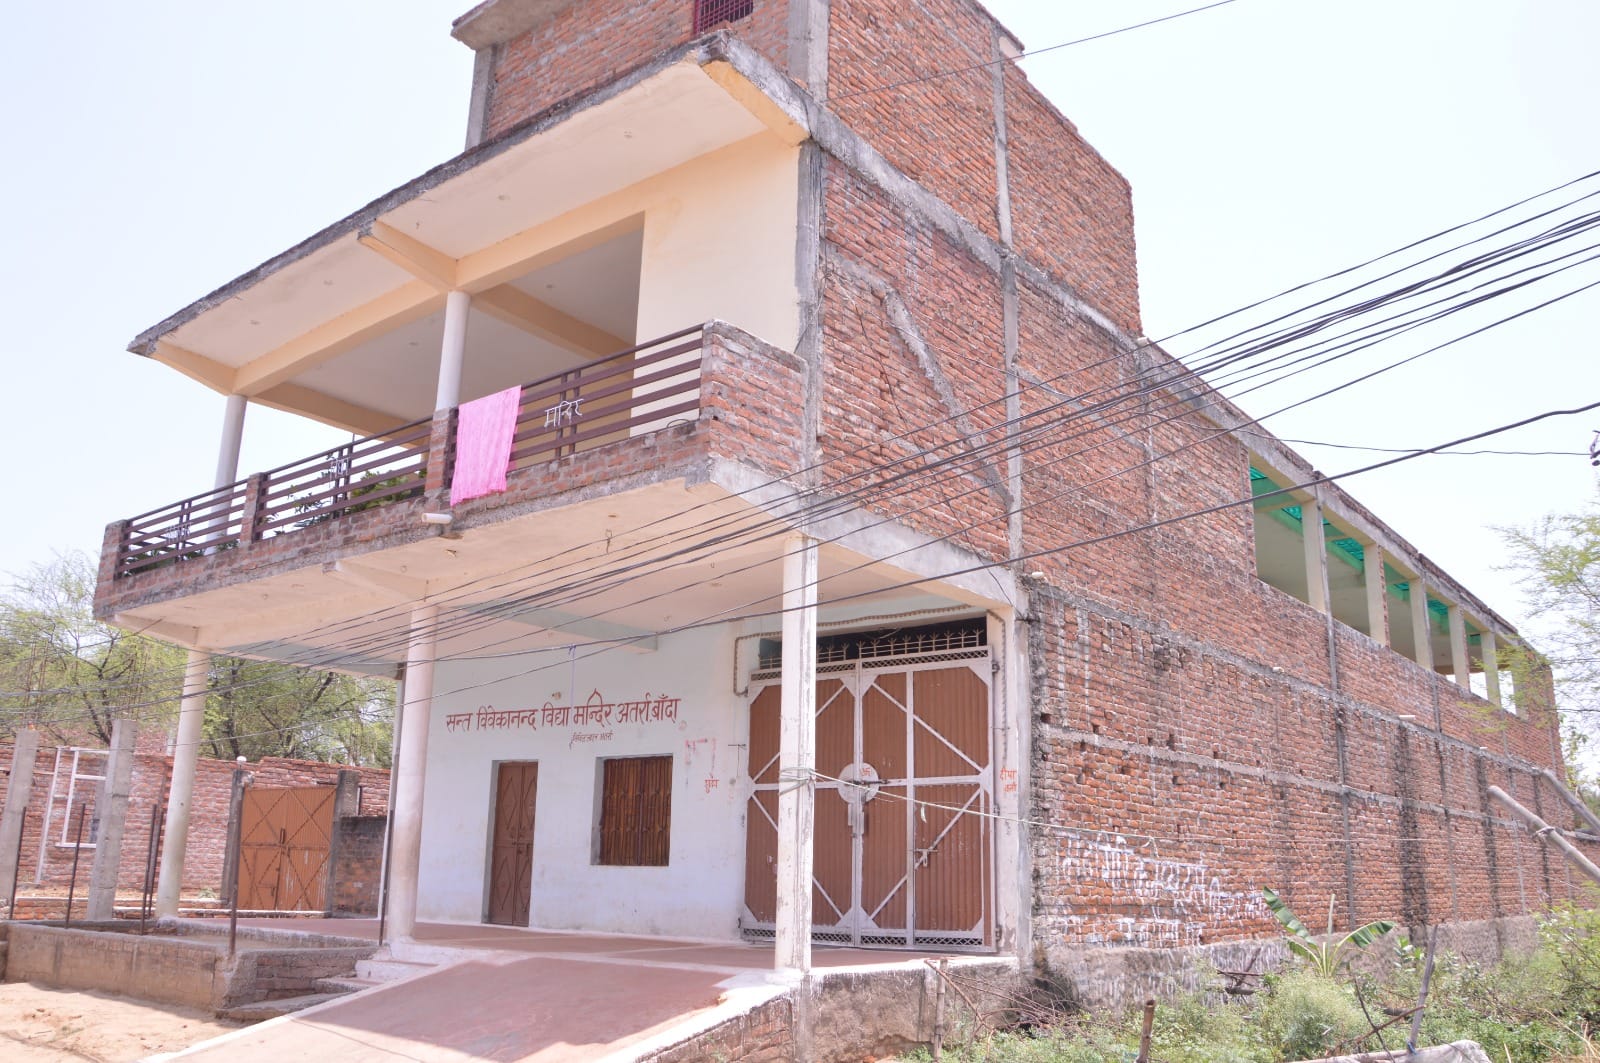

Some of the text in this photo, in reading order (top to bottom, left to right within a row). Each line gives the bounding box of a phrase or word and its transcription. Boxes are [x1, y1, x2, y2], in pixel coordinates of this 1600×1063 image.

[446, 712, 474, 733] सन्त
[476, 704, 539, 731] विवेकानन्द
[541, 701, 571, 728] विद्या
[573, 687, 616, 727] मन्दिर
